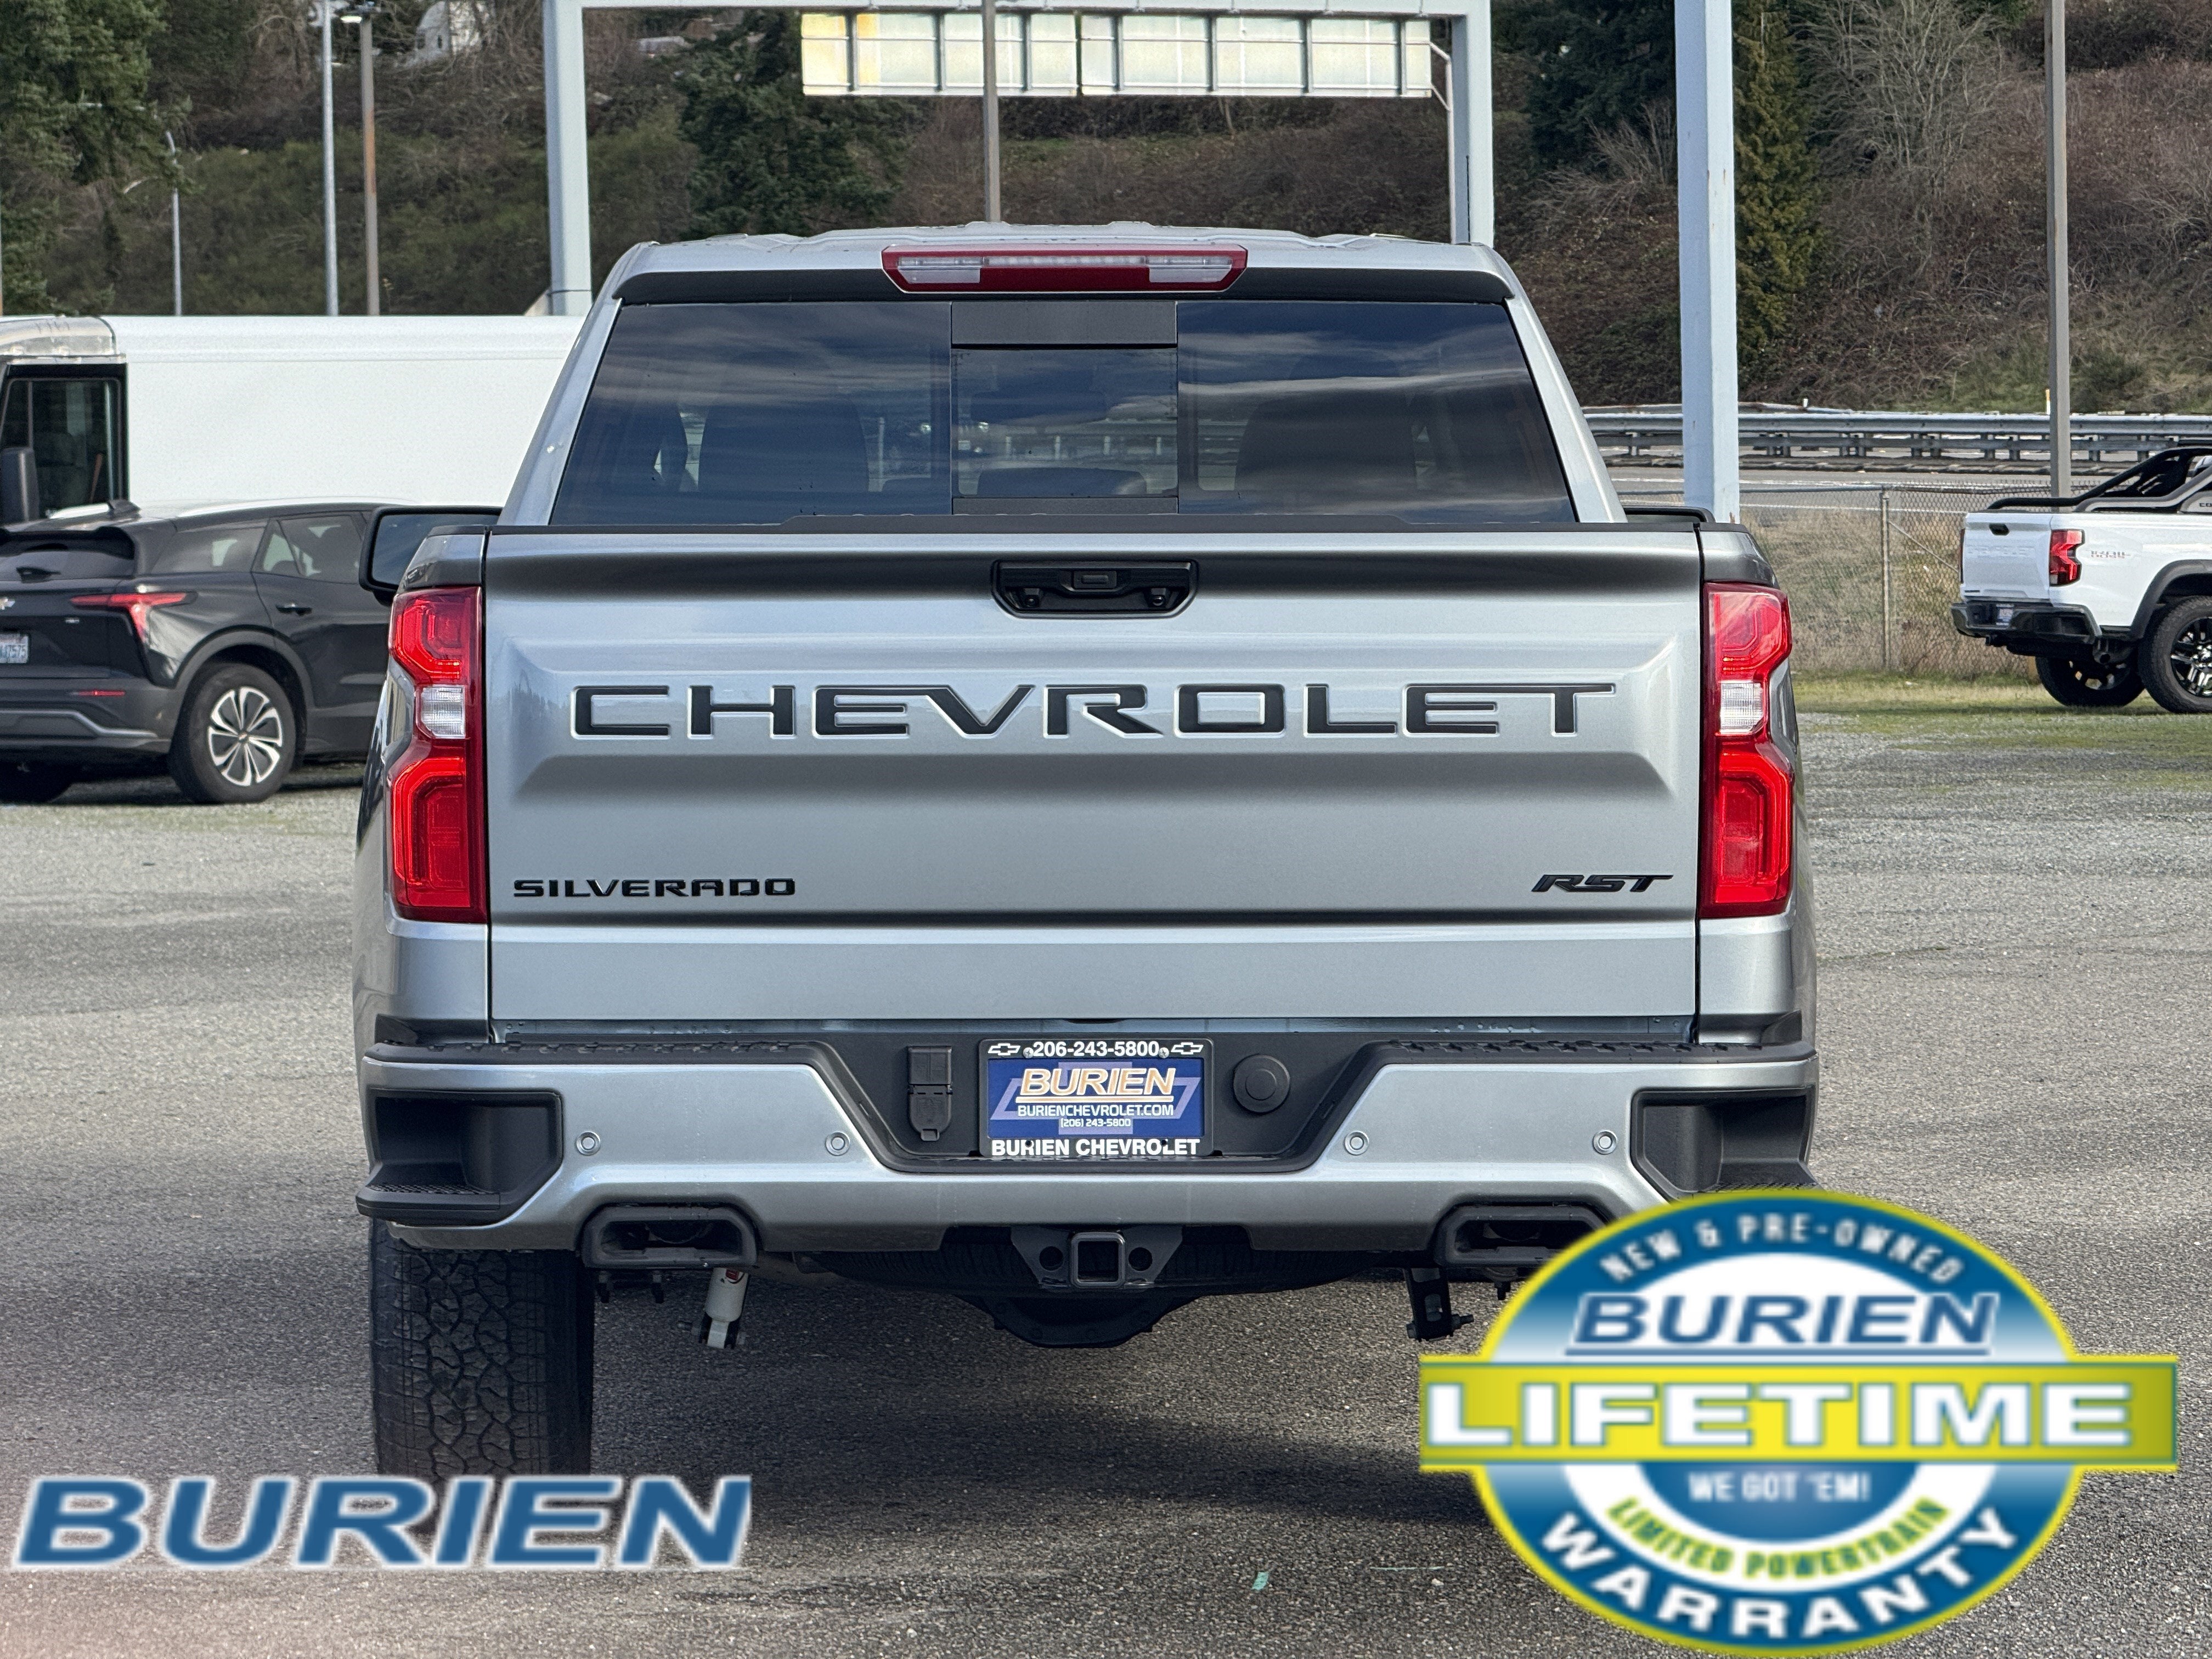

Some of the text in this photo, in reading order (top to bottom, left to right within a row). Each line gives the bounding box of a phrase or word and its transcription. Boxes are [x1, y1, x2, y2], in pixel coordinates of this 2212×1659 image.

[571, 685, 1616, 738] CHEVROLET
[514, 878, 795, 897] SILVERADO
[1531, 874, 1674, 892] RST
[1033, 1041, 1159, 1057] 206-243-5800
[1020, 1067, 1176, 1096] BURIEN
[1018, 1104, 1173, 1116] BURIENCHEVROLET.COM
[1060, 1118, 1131, 1128] (206) 243-5800
[991, 1139, 1200, 1156] BURIEN CHEVROLET
